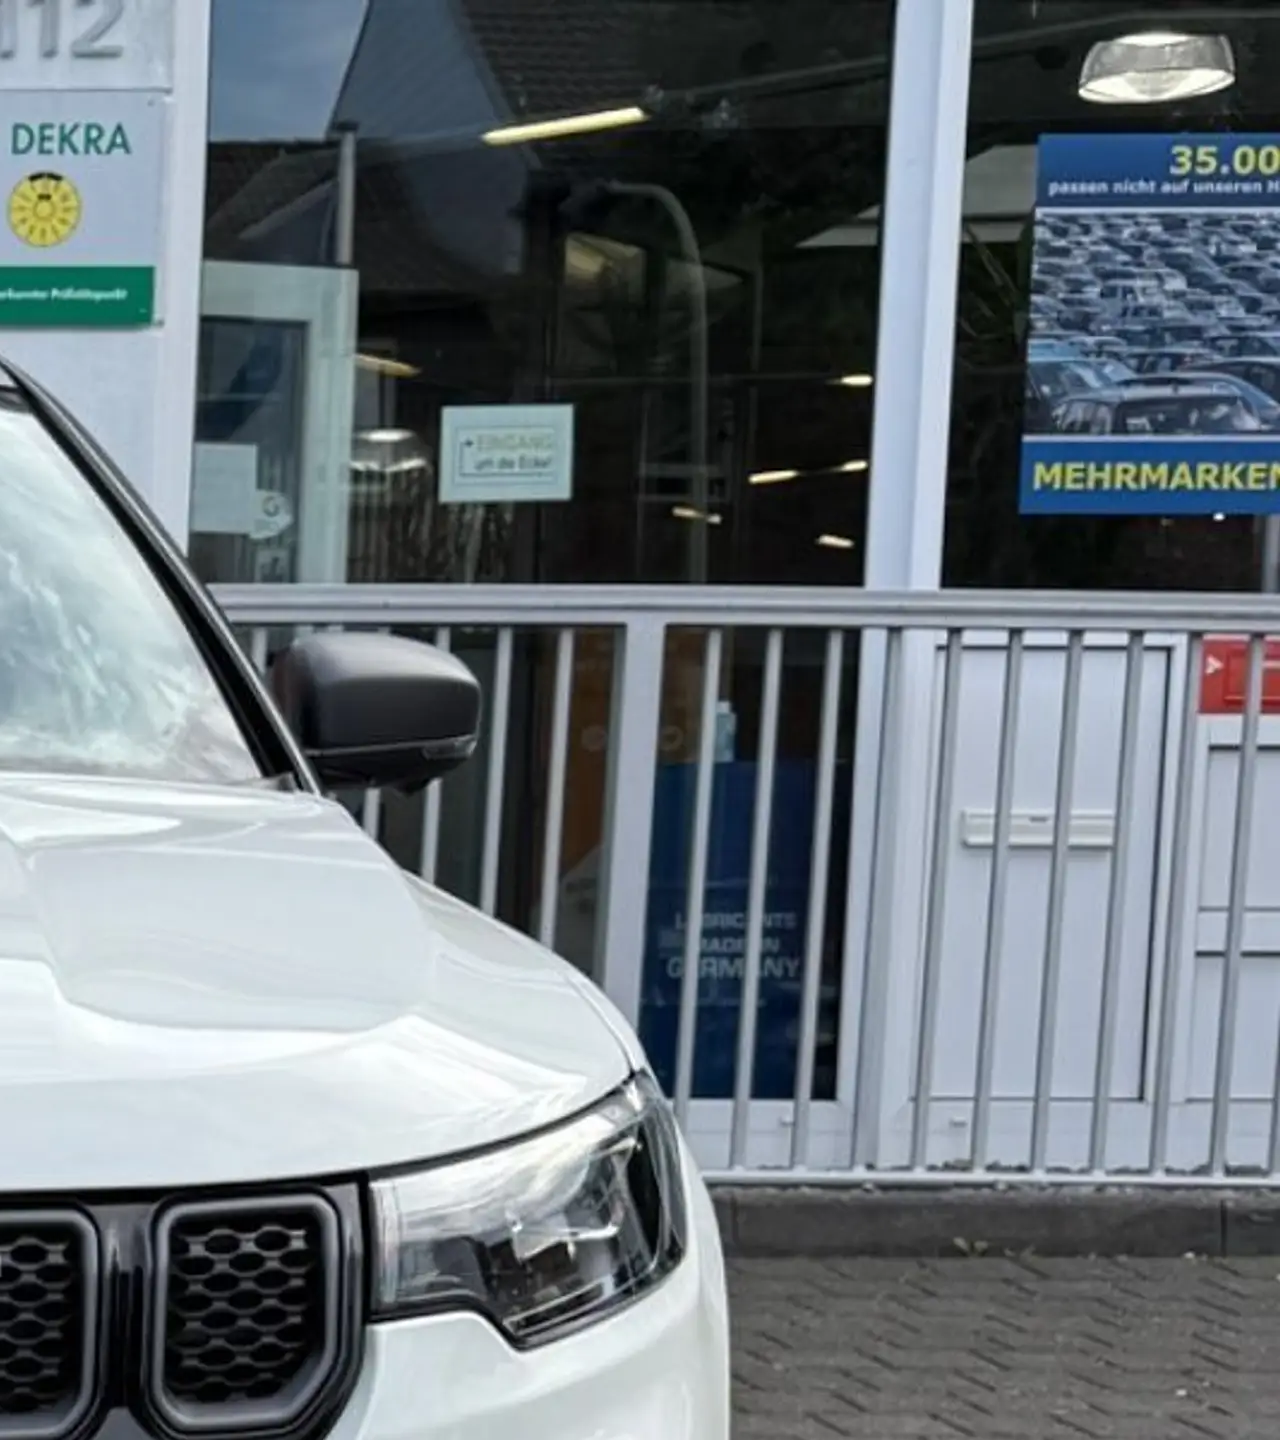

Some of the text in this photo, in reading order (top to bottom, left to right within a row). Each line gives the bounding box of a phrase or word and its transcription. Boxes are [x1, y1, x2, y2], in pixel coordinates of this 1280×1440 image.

[10, 122, 132, 155] DEKRA
[1048, 181, 1108, 197] passen
[1113, 178, 1155, 194] nicht
[1160, 178, 1189, 194] auf
[1193, 181, 1262, 194] unseren
[666, 956, 799, 980] GRMNY
